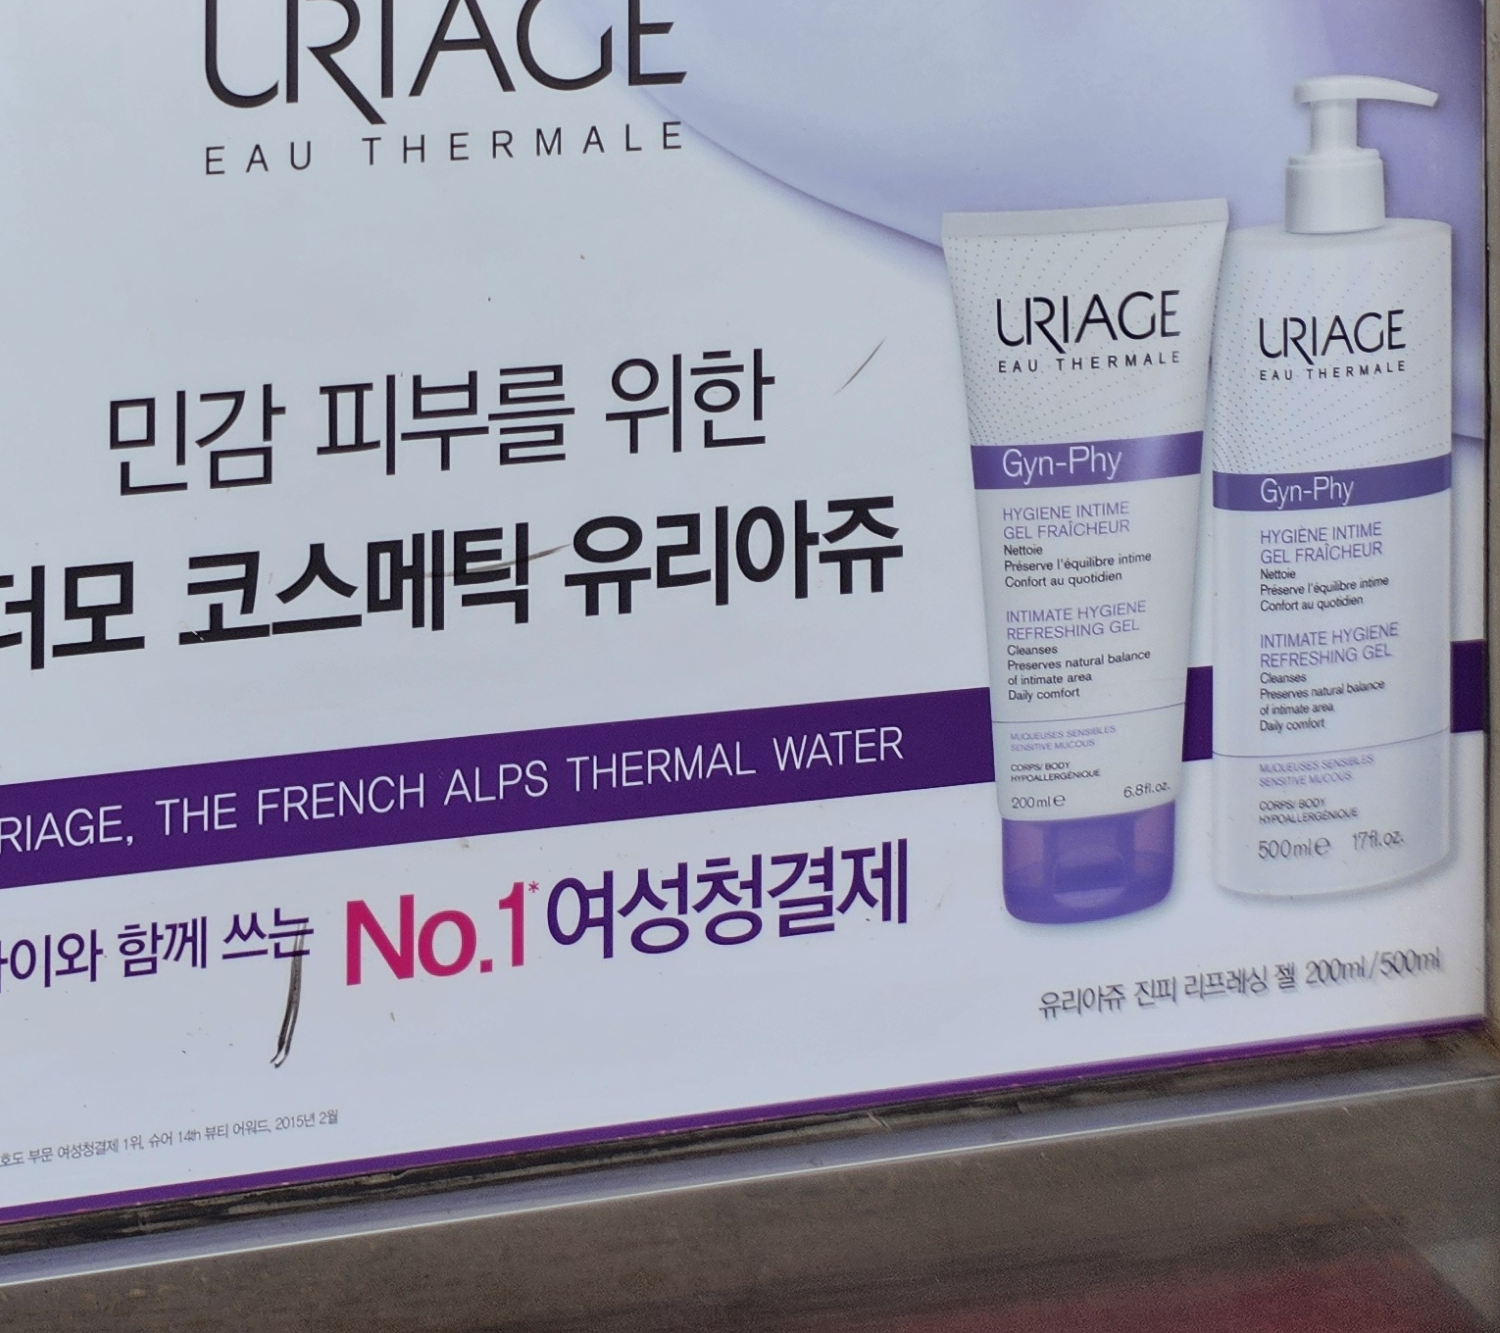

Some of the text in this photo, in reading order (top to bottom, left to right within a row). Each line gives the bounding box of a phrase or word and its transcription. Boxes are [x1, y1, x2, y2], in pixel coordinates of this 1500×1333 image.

[204, 120, 683, 176] EAU THERMALE
[996, 290, 1181, 354] URIAGE
[1258, 309, 1407, 365] URIAGE
[998, 351, 1181, 374] EAU THERMALE
[1259, 360, 1406, 381] EAU THERMALE
[108, 348, 776, 496] 민감 피부를 위한
[1002, 447, 1123, 486] Gyn-Phy
[1260, 478, 1355, 507] Gyn-Phy
[1076, 500, 1130, 518] INTIME
[1003, 518, 1131, 540] GEL FRAÎCHEUR
[1004, 544, 1043, 557] Nettoie
[1004, 559, 1054, 573] Préserve
[1118, 551, 1152, 564] intime
[1260, 541, 1383, 564] GEL FRAÎCHEUR
[178, 522, 531, 646] 코스메틱
[563, 495, 904, 617] 유리아쥬
[1005, 570, 1123, 589] Confort au quotidien
[1260, 568, 1296, 581] Nettoie
[1006, 600, 1147, 624] INTIMATE HYGIENE
[1260, 595, 1364, 613] Confort au quotidien
[1006, 618, 1140, 641] REFRESHING GEL
[1260, 622, 1399, 649] INTIMATE HYGIENE
[1006, 643, 1058, 657] Cleanses
[1007, 649, 1151, 671] Preserves natural balance
[1260, 643, 1392, 669] REFRESHING GEL
[1008, 671, 1093, 686] of intimate area
[1008, 686, 1080, 702] Daily comfort
[155, 792, 238, 838] THE
[256, 773, 427, 823] FRENCH
[443, 759, 549, 806] ALPS
[566, 741, 757, 793] THERMAL
[773, 724, 905, 770] WATER
[116, 914, 208, 979] 함께
[222, 905, 315, 961] 쓰는
[545, 837, 910, 960] 여성청결제
[1038, 981, 1127, 1019] 유리아쥬
[1133, 975, 1177, 1007] 진피
[1184, 965, 1268, 998] 리프레싱
[1275, 961, 1296, 991] 젤
[28, 1145, 54, 1164] 부문
[275, 1111, 316, 1131] 2015년
